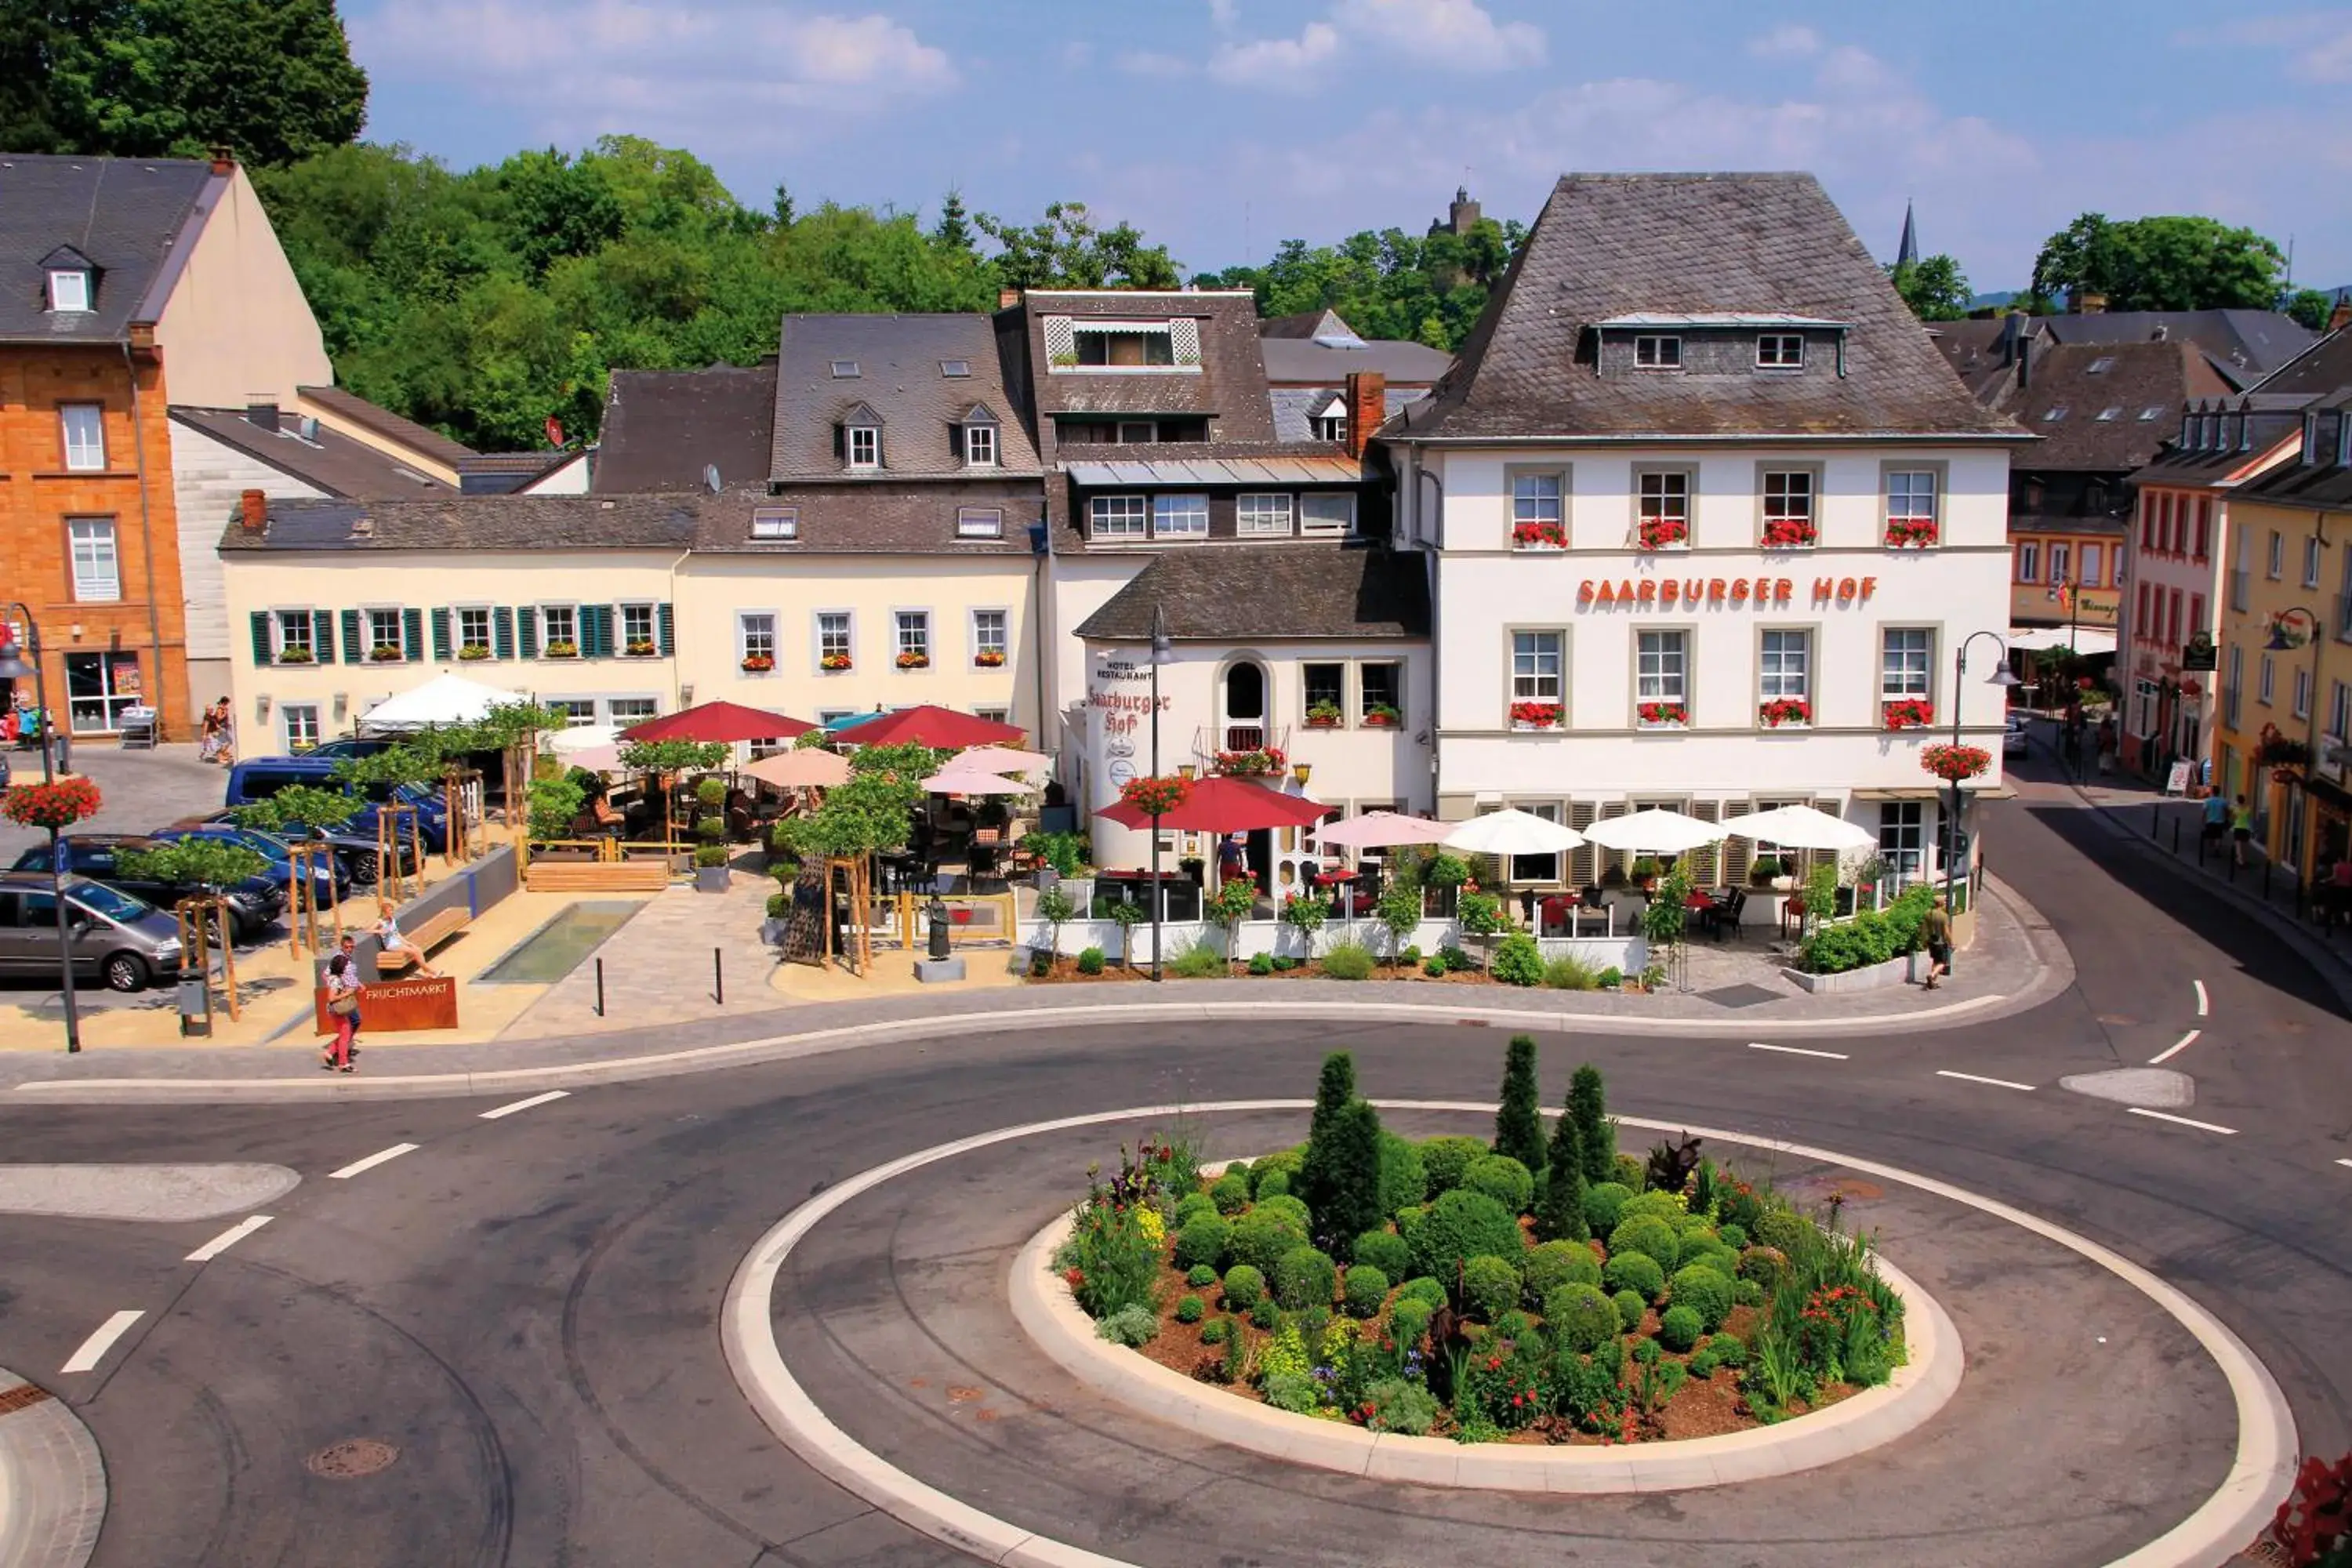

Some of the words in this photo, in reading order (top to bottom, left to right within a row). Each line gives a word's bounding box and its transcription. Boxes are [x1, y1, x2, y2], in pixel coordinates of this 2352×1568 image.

[1578, 578, 1793, 603] SAARBURGER
[1815, 576, 1877, 601] HOF
[1106, 661, 1135, 670] HOTEL
[1097, 670, 1153, 681] RESTAURANT
[57, 843, 67, 869] P
[365, 983, 448, 1000] FRUCHTMARKT
